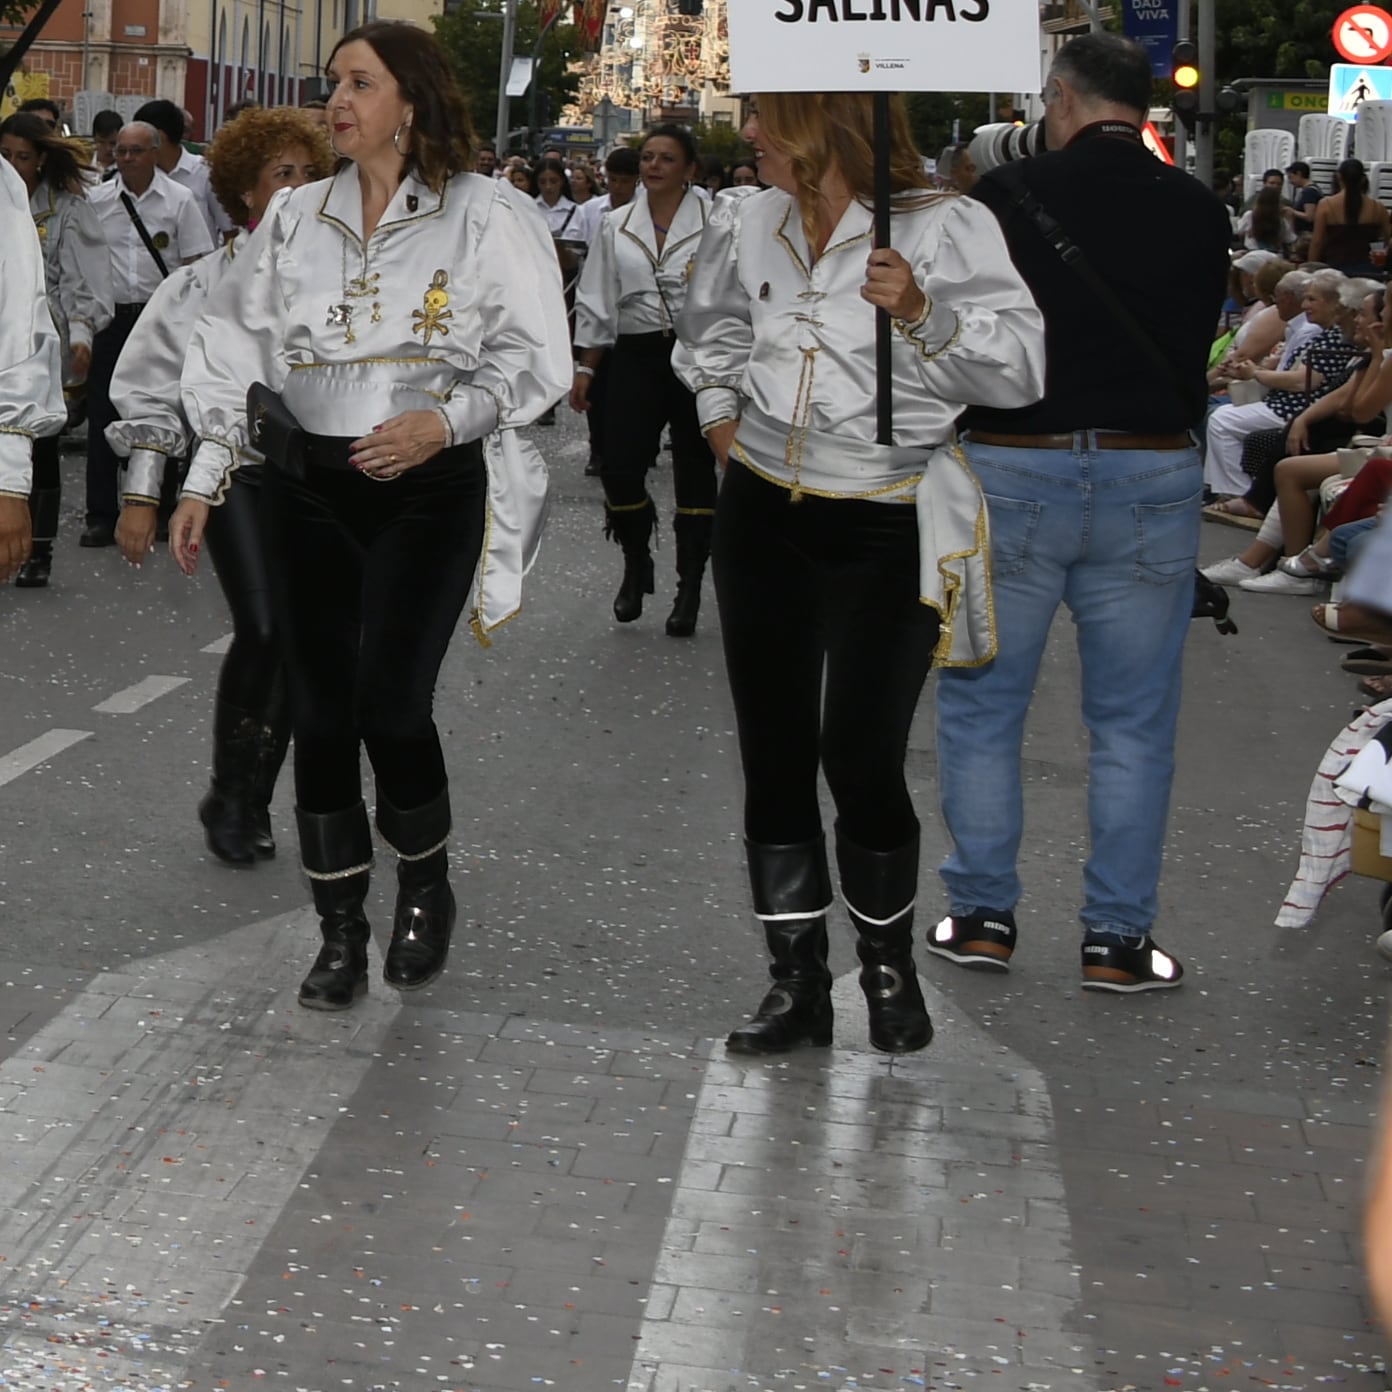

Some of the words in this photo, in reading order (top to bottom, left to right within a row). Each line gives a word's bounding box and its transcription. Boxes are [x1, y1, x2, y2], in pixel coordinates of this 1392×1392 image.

[1135, 9, 1170, 21] VIVA
[875, 62, 905, 70] VILLENA
[1290, 95, 1329, 108] ONC
